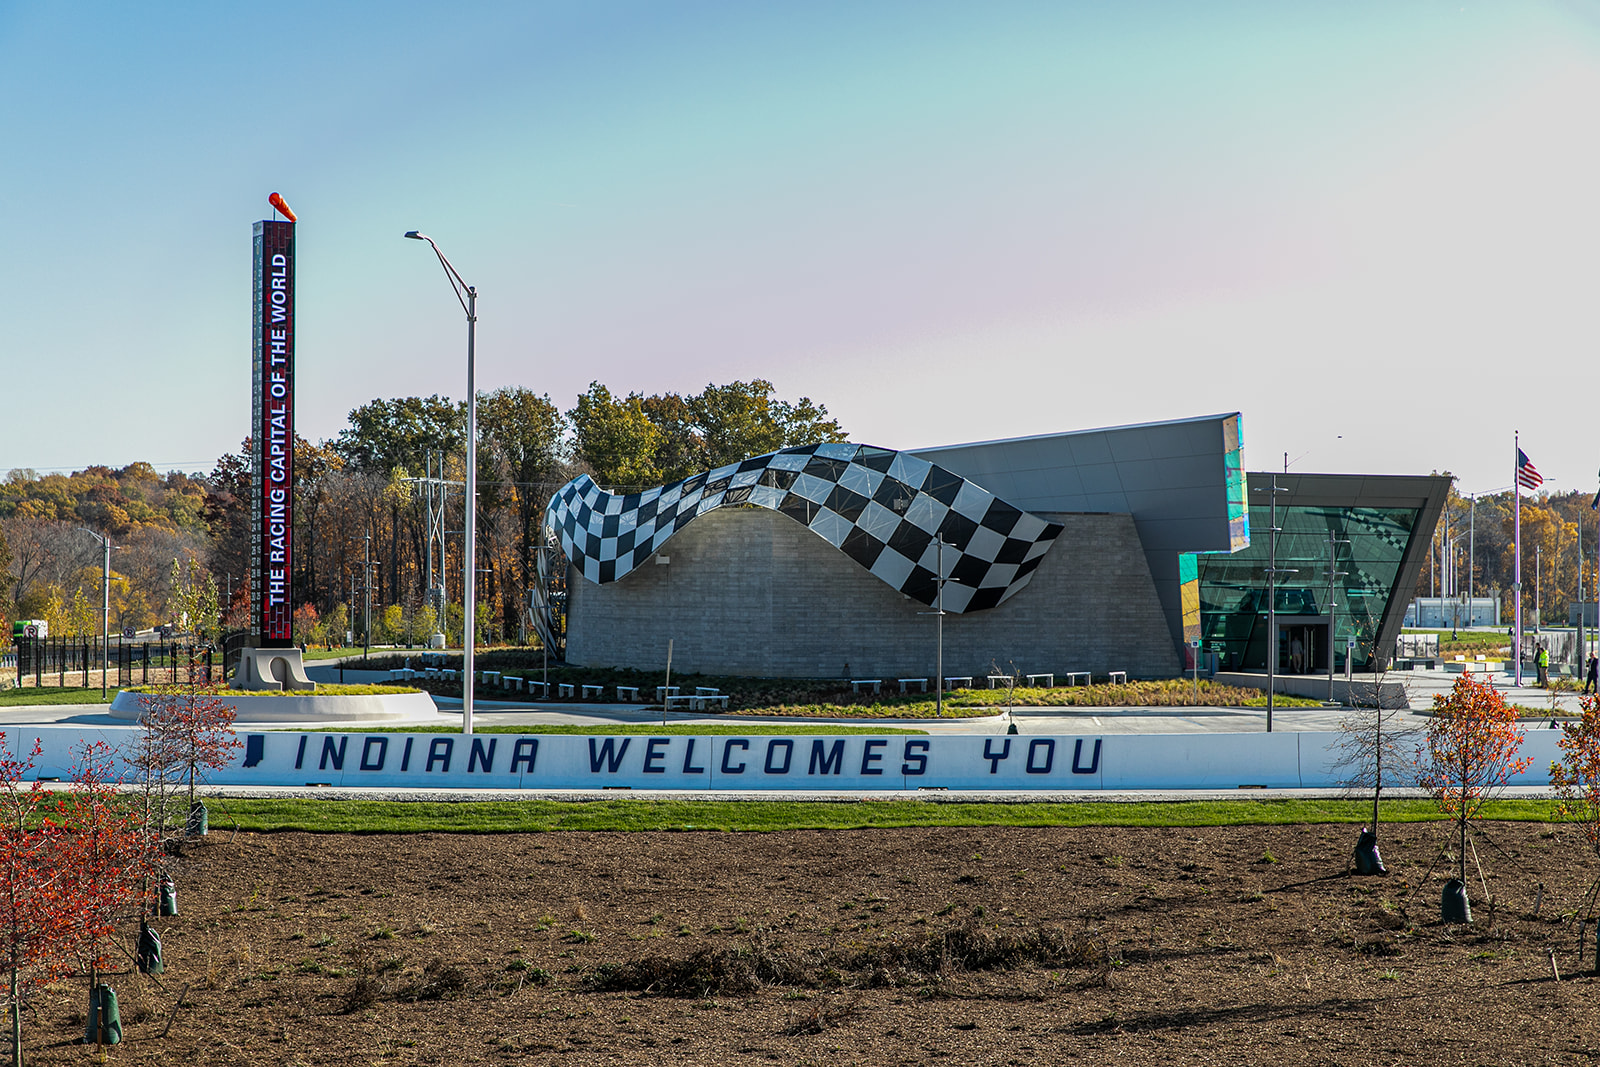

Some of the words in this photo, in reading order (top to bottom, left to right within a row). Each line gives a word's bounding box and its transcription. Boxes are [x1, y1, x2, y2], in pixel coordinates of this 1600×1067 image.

[271, 254, 286, 322] WORLD
[271, 329, 286, 366] THE
[271, 372, 286, 398] OF
[270, 405, 286, 481] CAPITAL
[270, 489, 285, 562] RACING
[270, 569, 284, 606] THE
[295, 735, 539, 772] INDIANA
[588, 739, 929, 774] WELCOMES
[983, 739, 1102, 774] YOU
